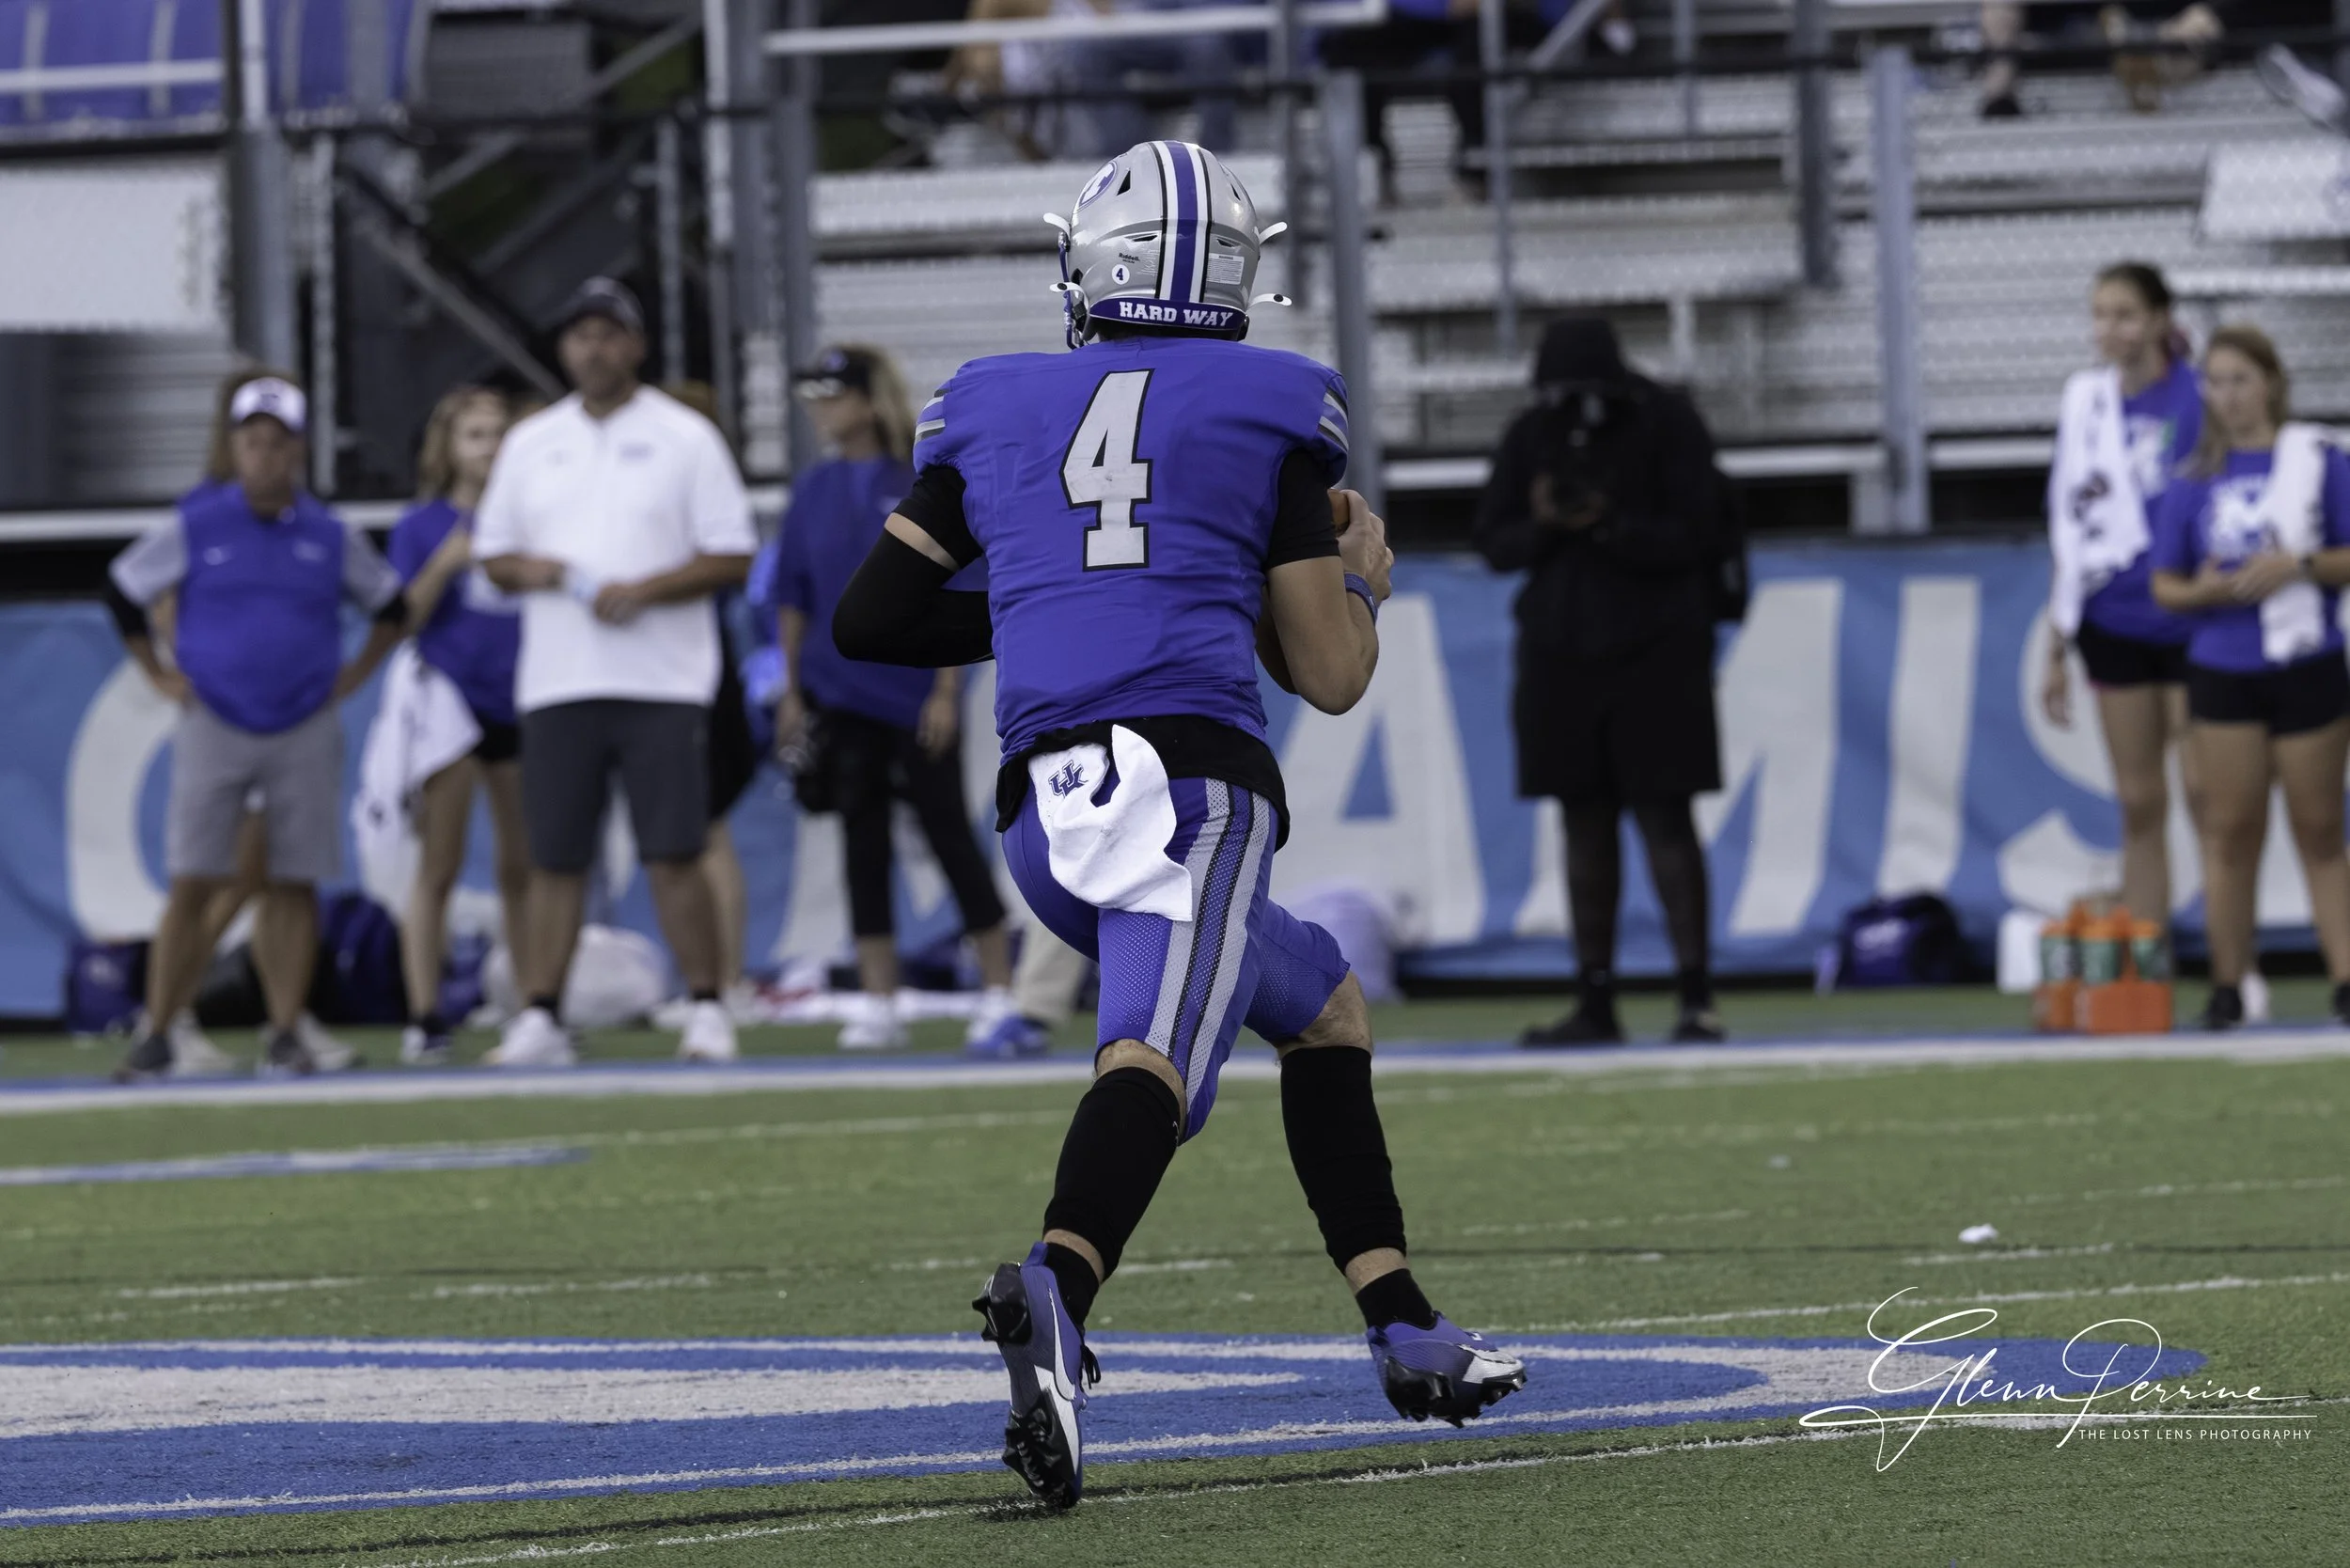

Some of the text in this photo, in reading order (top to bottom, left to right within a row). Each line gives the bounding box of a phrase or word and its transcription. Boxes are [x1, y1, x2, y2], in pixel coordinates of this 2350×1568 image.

[1116, 267, 1124, 281] 4
[1119, 301, 1234, 327] HARD WAY
[1058, 368, 1155, 572] 4
